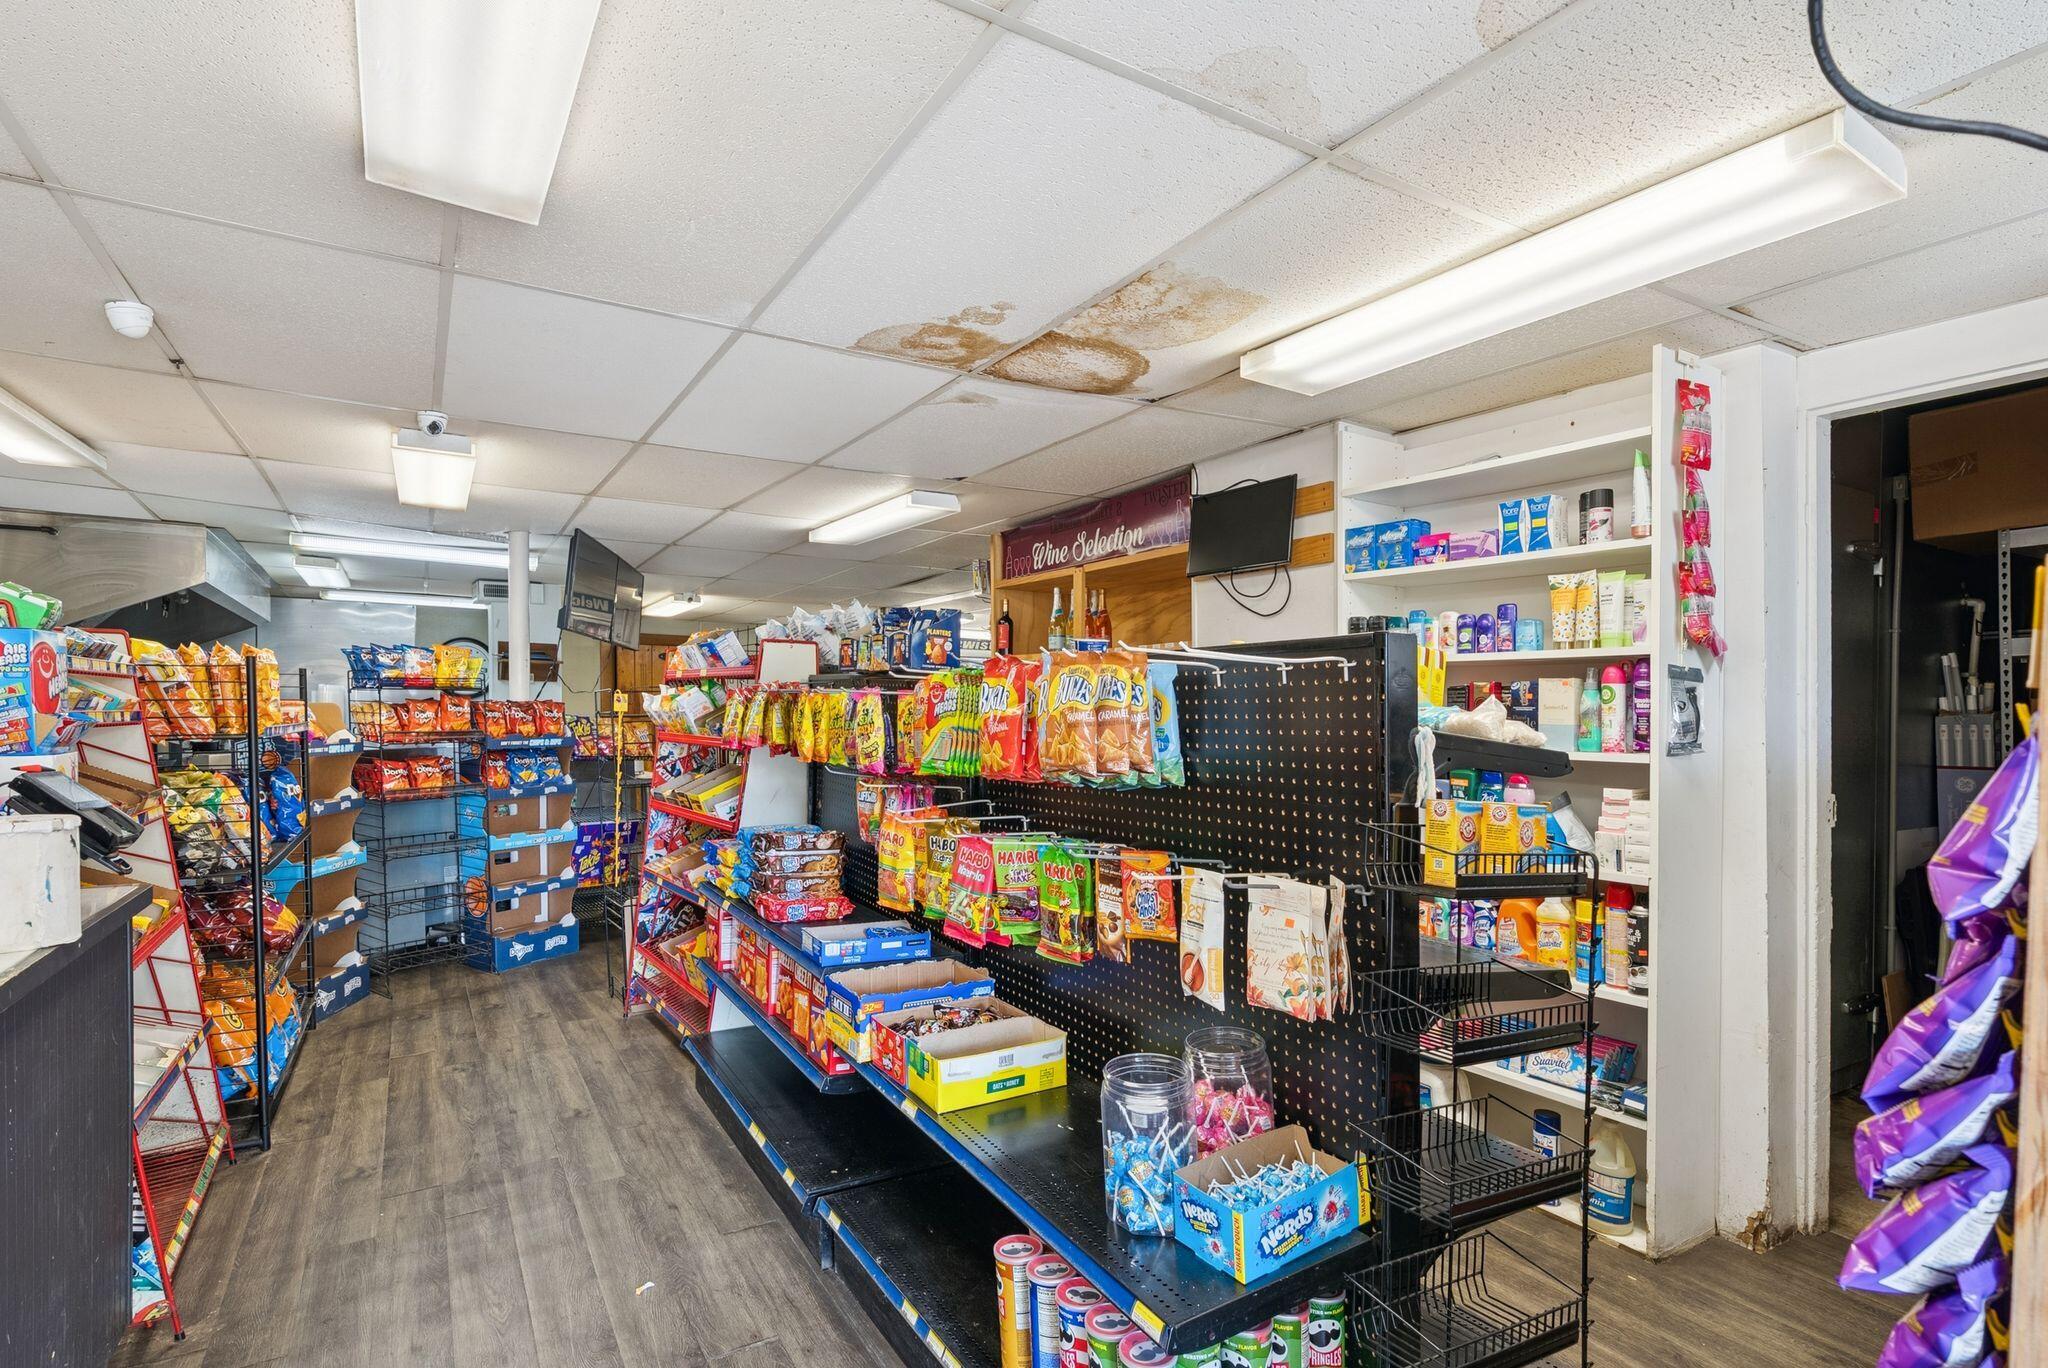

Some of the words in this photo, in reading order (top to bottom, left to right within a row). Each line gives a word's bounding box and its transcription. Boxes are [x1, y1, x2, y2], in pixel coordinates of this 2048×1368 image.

[1032, 540, 1068, 570] Wine
[1072, 525, 1146, 561] Selection
[926, 628, 952, 637] PLANTERS
[4, 643, 27, 655] AIR
[1096, 674, 1126, 704] UGLES
[1098, 884, 1122, 895] unior
[864, 1004, 874, 1012] 32
[1532, 1055, 1571, 1070] Suavitel
[1311, 1349, 1342, 1367] RINGLES
